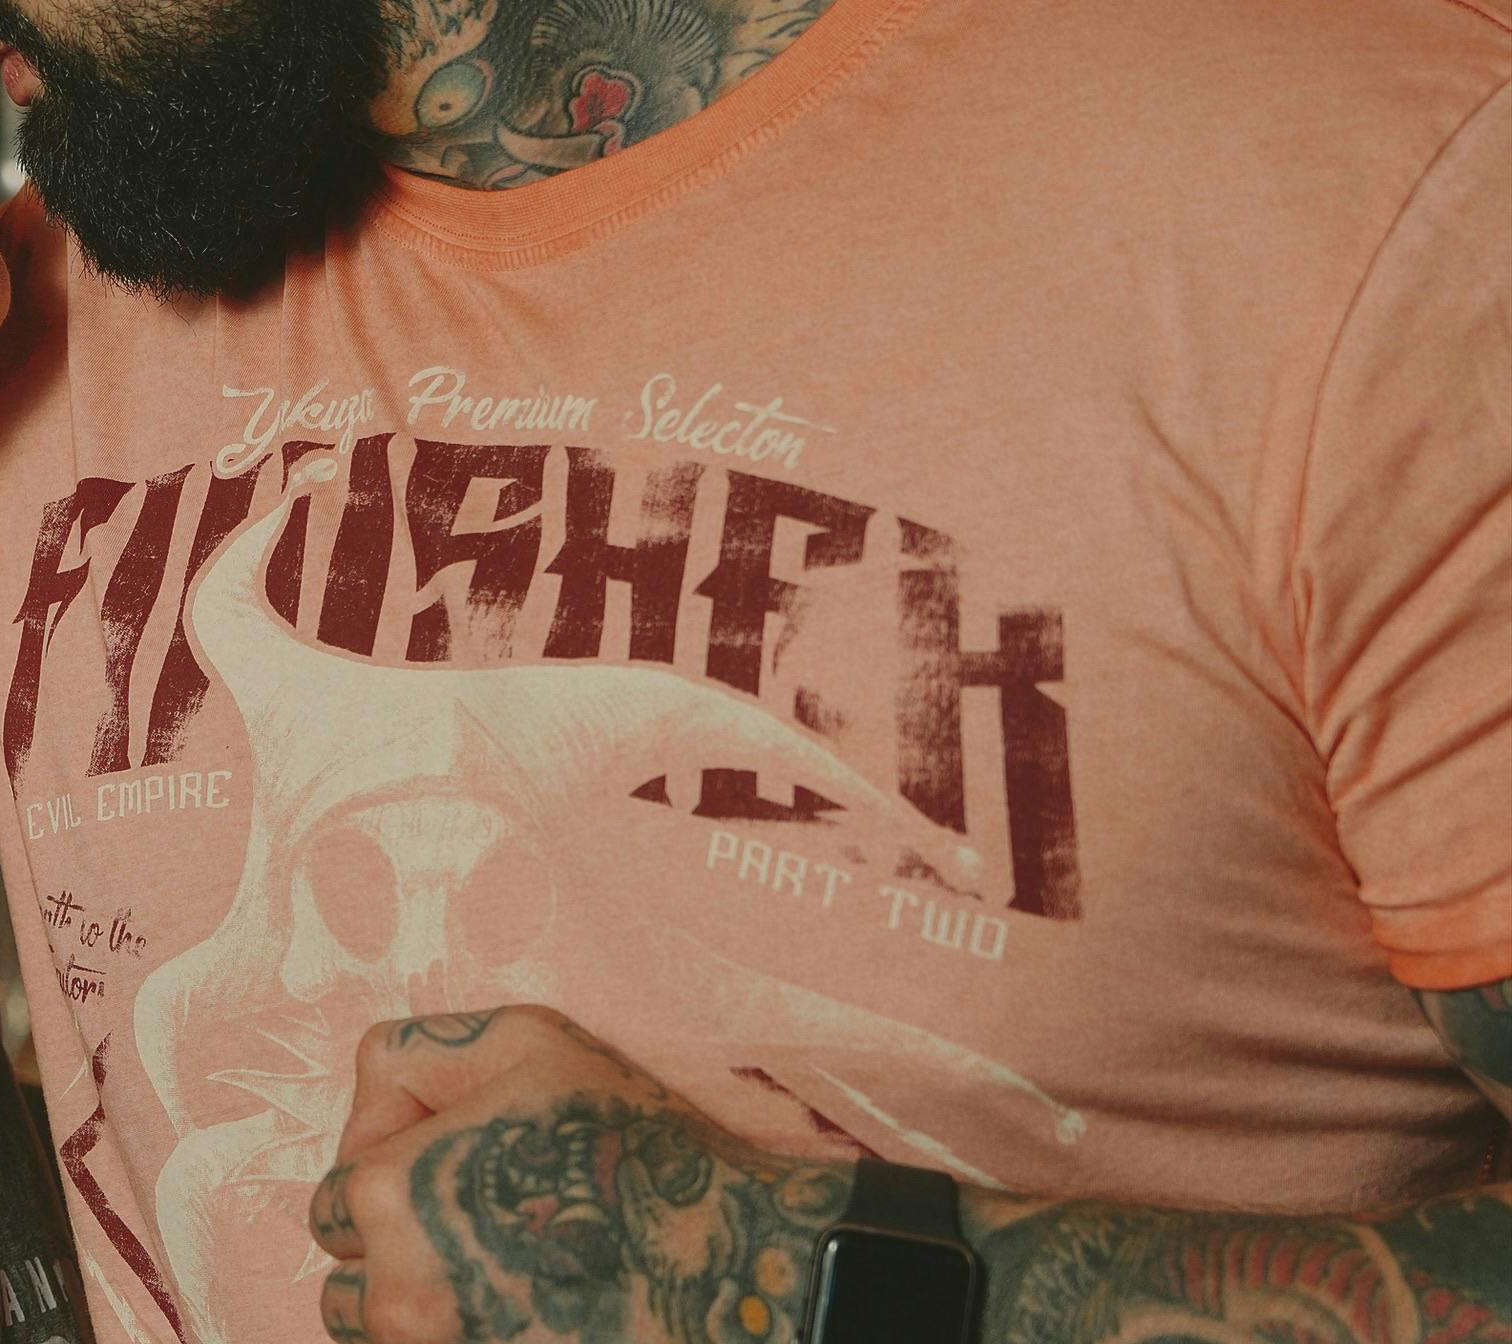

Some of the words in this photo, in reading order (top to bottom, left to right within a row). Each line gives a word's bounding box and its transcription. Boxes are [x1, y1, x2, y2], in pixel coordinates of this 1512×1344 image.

[408, 366, 598, 432] Premium
[26, 792, 82, 840] EVIL
[97, 771, 233, 822] EMPIRE
[706, 830, 852, 910] PART
[881, 886, 1008, 960] TWO
